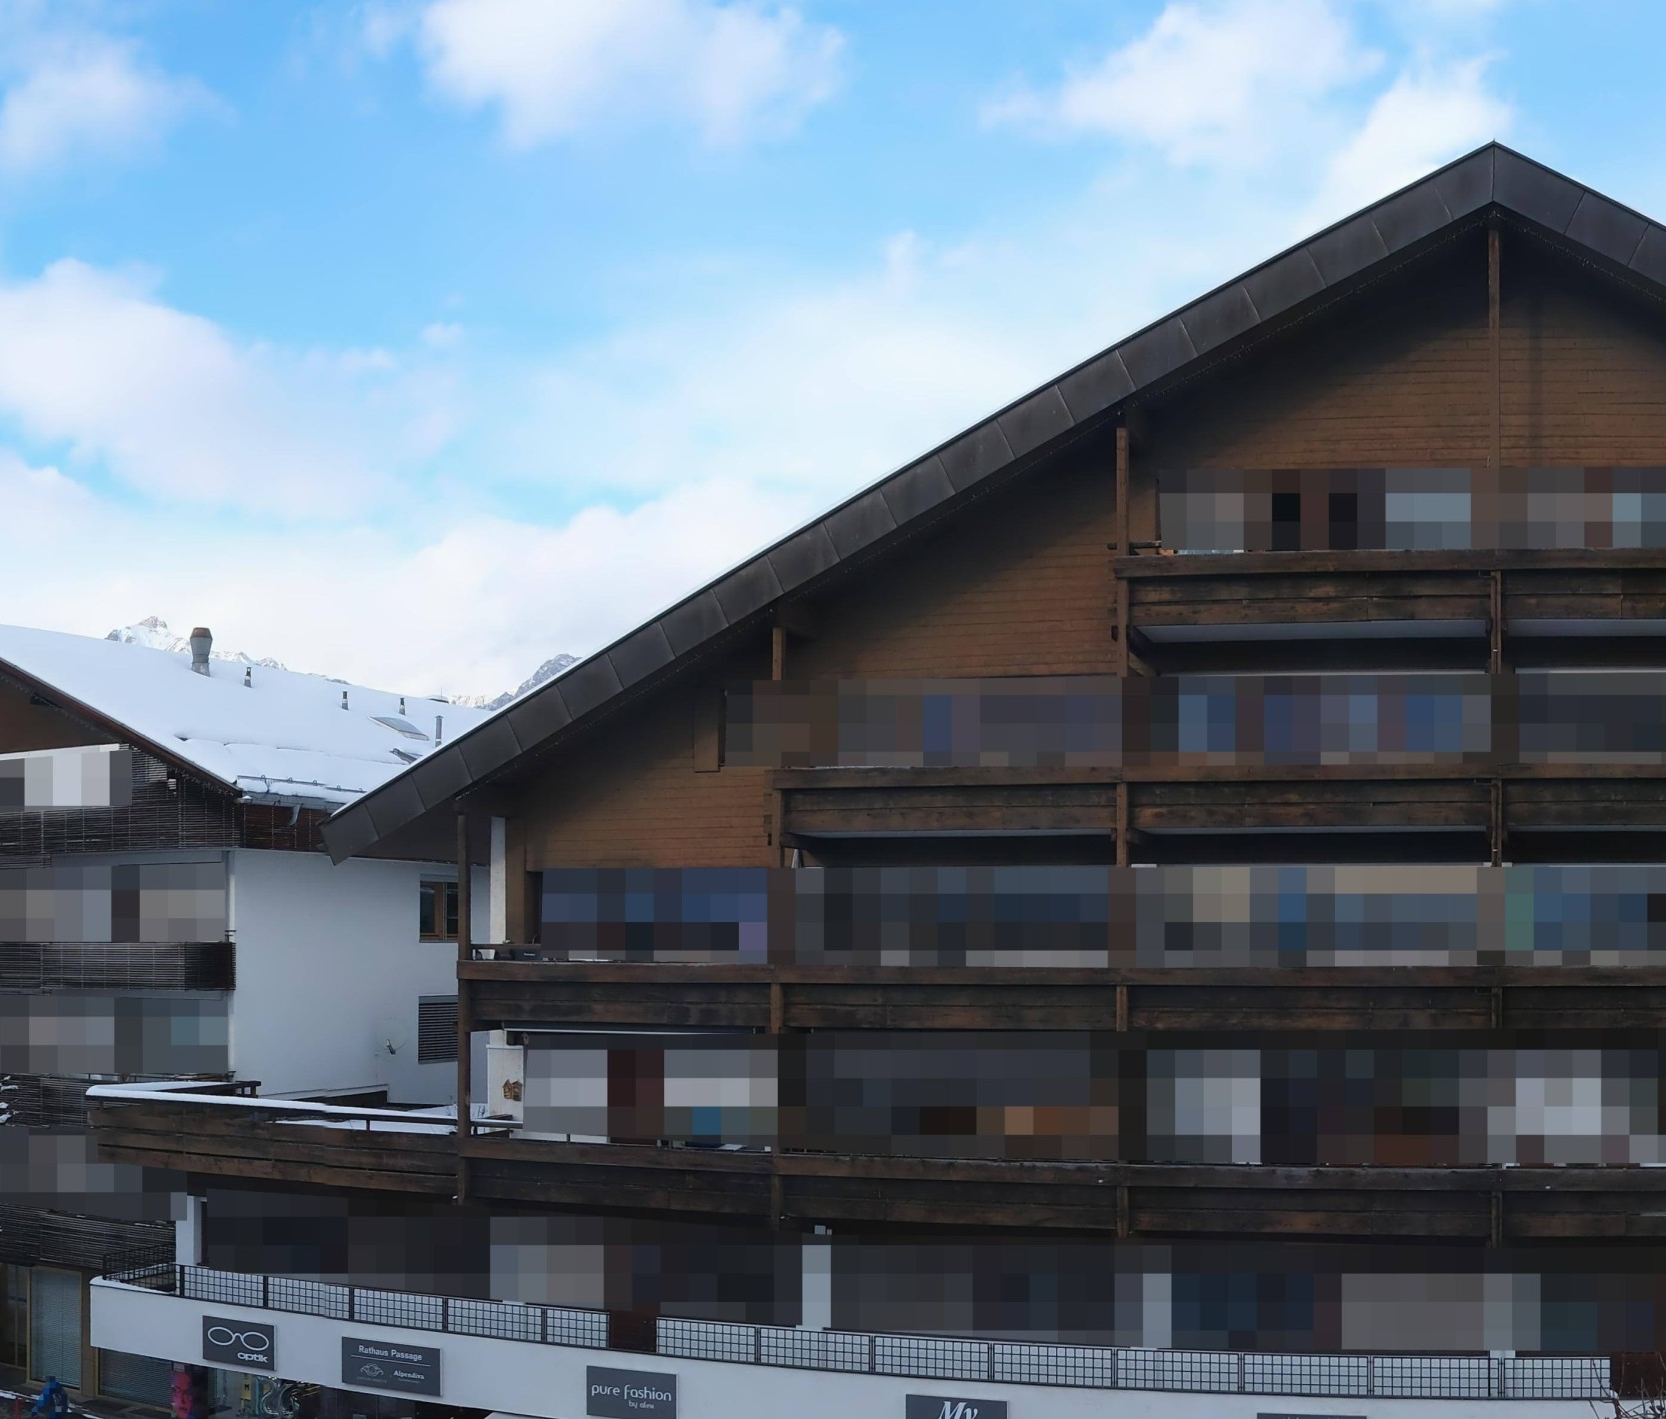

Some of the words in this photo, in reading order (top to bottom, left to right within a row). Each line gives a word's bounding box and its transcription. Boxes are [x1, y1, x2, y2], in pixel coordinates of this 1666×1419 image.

[237, 1351, 269, 1364] optik
[358, 1344, 389, 1357] Rathaus
[391, 1349, 423, 1362] Passage
[591, 1384, 620, 1396] pure
[624, 1384, 672, 1401] fashion
[628, 1400, 638, 1409] by
